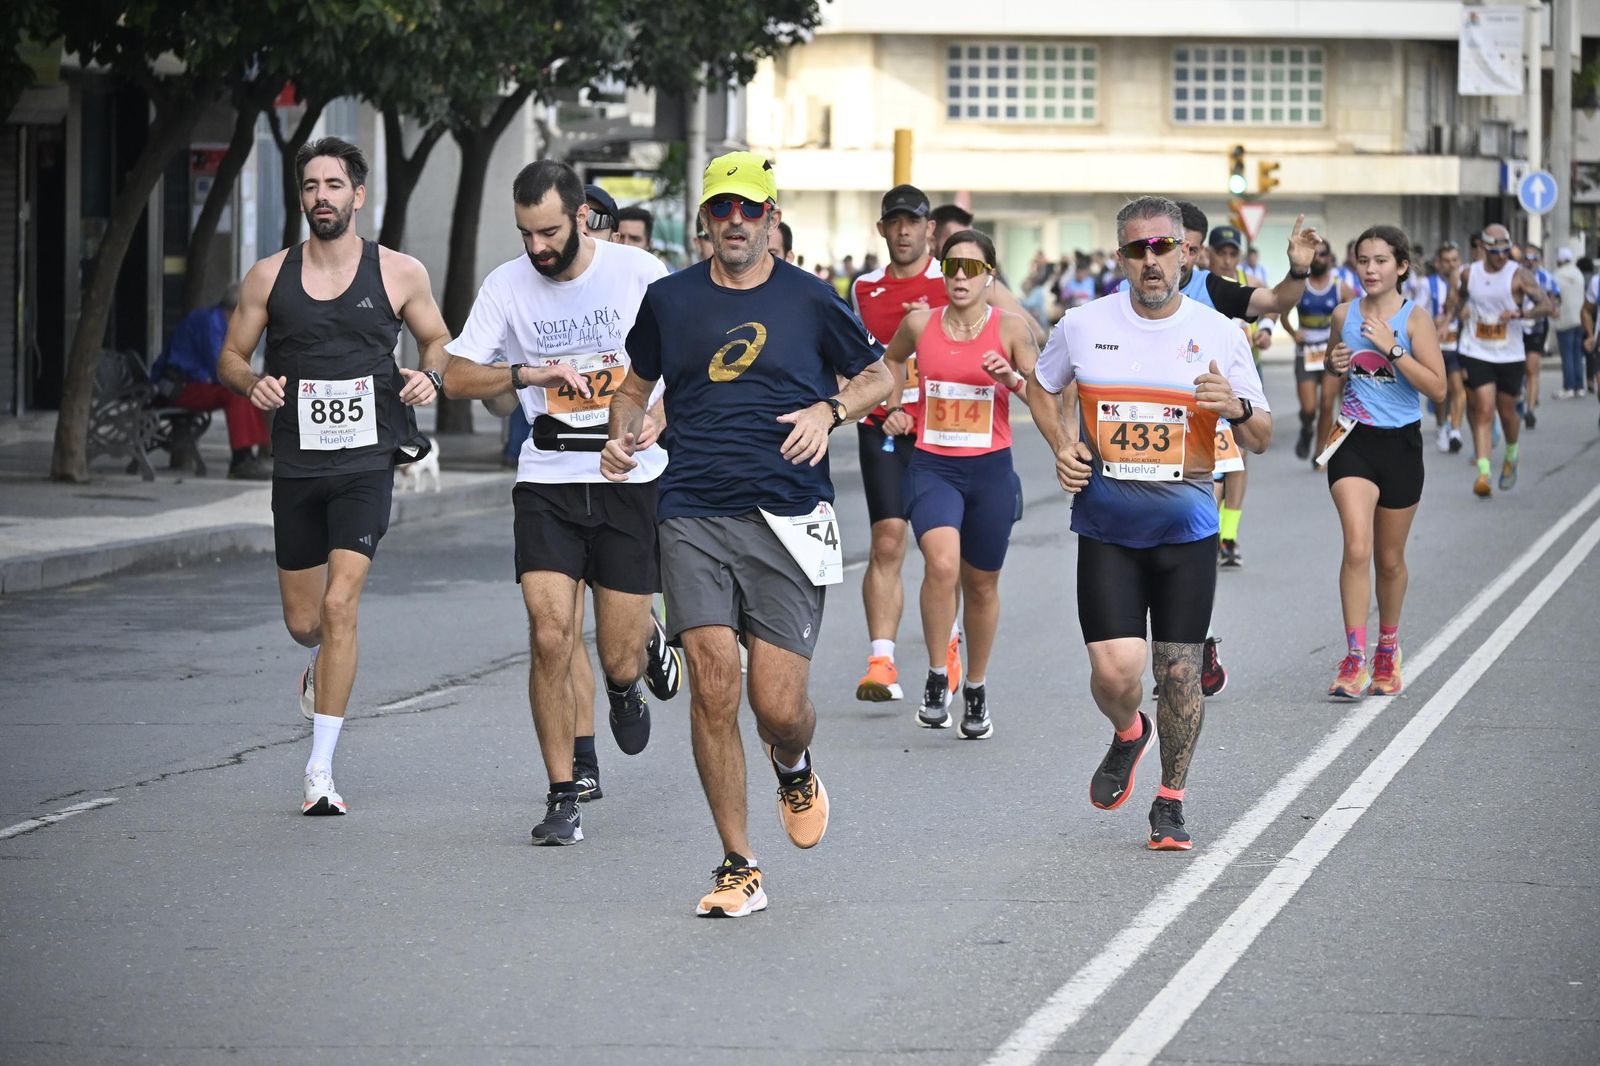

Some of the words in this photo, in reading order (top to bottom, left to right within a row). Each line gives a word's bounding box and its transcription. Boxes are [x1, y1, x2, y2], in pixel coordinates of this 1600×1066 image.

[533, 318, 578, 335] VOLTA
[594, 306, 621, 325] RÍA
[537, 329, 573, 353] Memorial
[1095, 343, 1119, 351] FASTER
[311, 397, 364, 424] 885
[570, 411, 606, 422] Huelva
[935, 399, 980, 423] 514
[320, 435, 354, 444] Huelva
[938, 433, 969, 442] Huelva
[1110, 422, 1170, 452] 433
[1119, 464, 1156, 474] Huelva
[806, 521, 838, 551] 54
